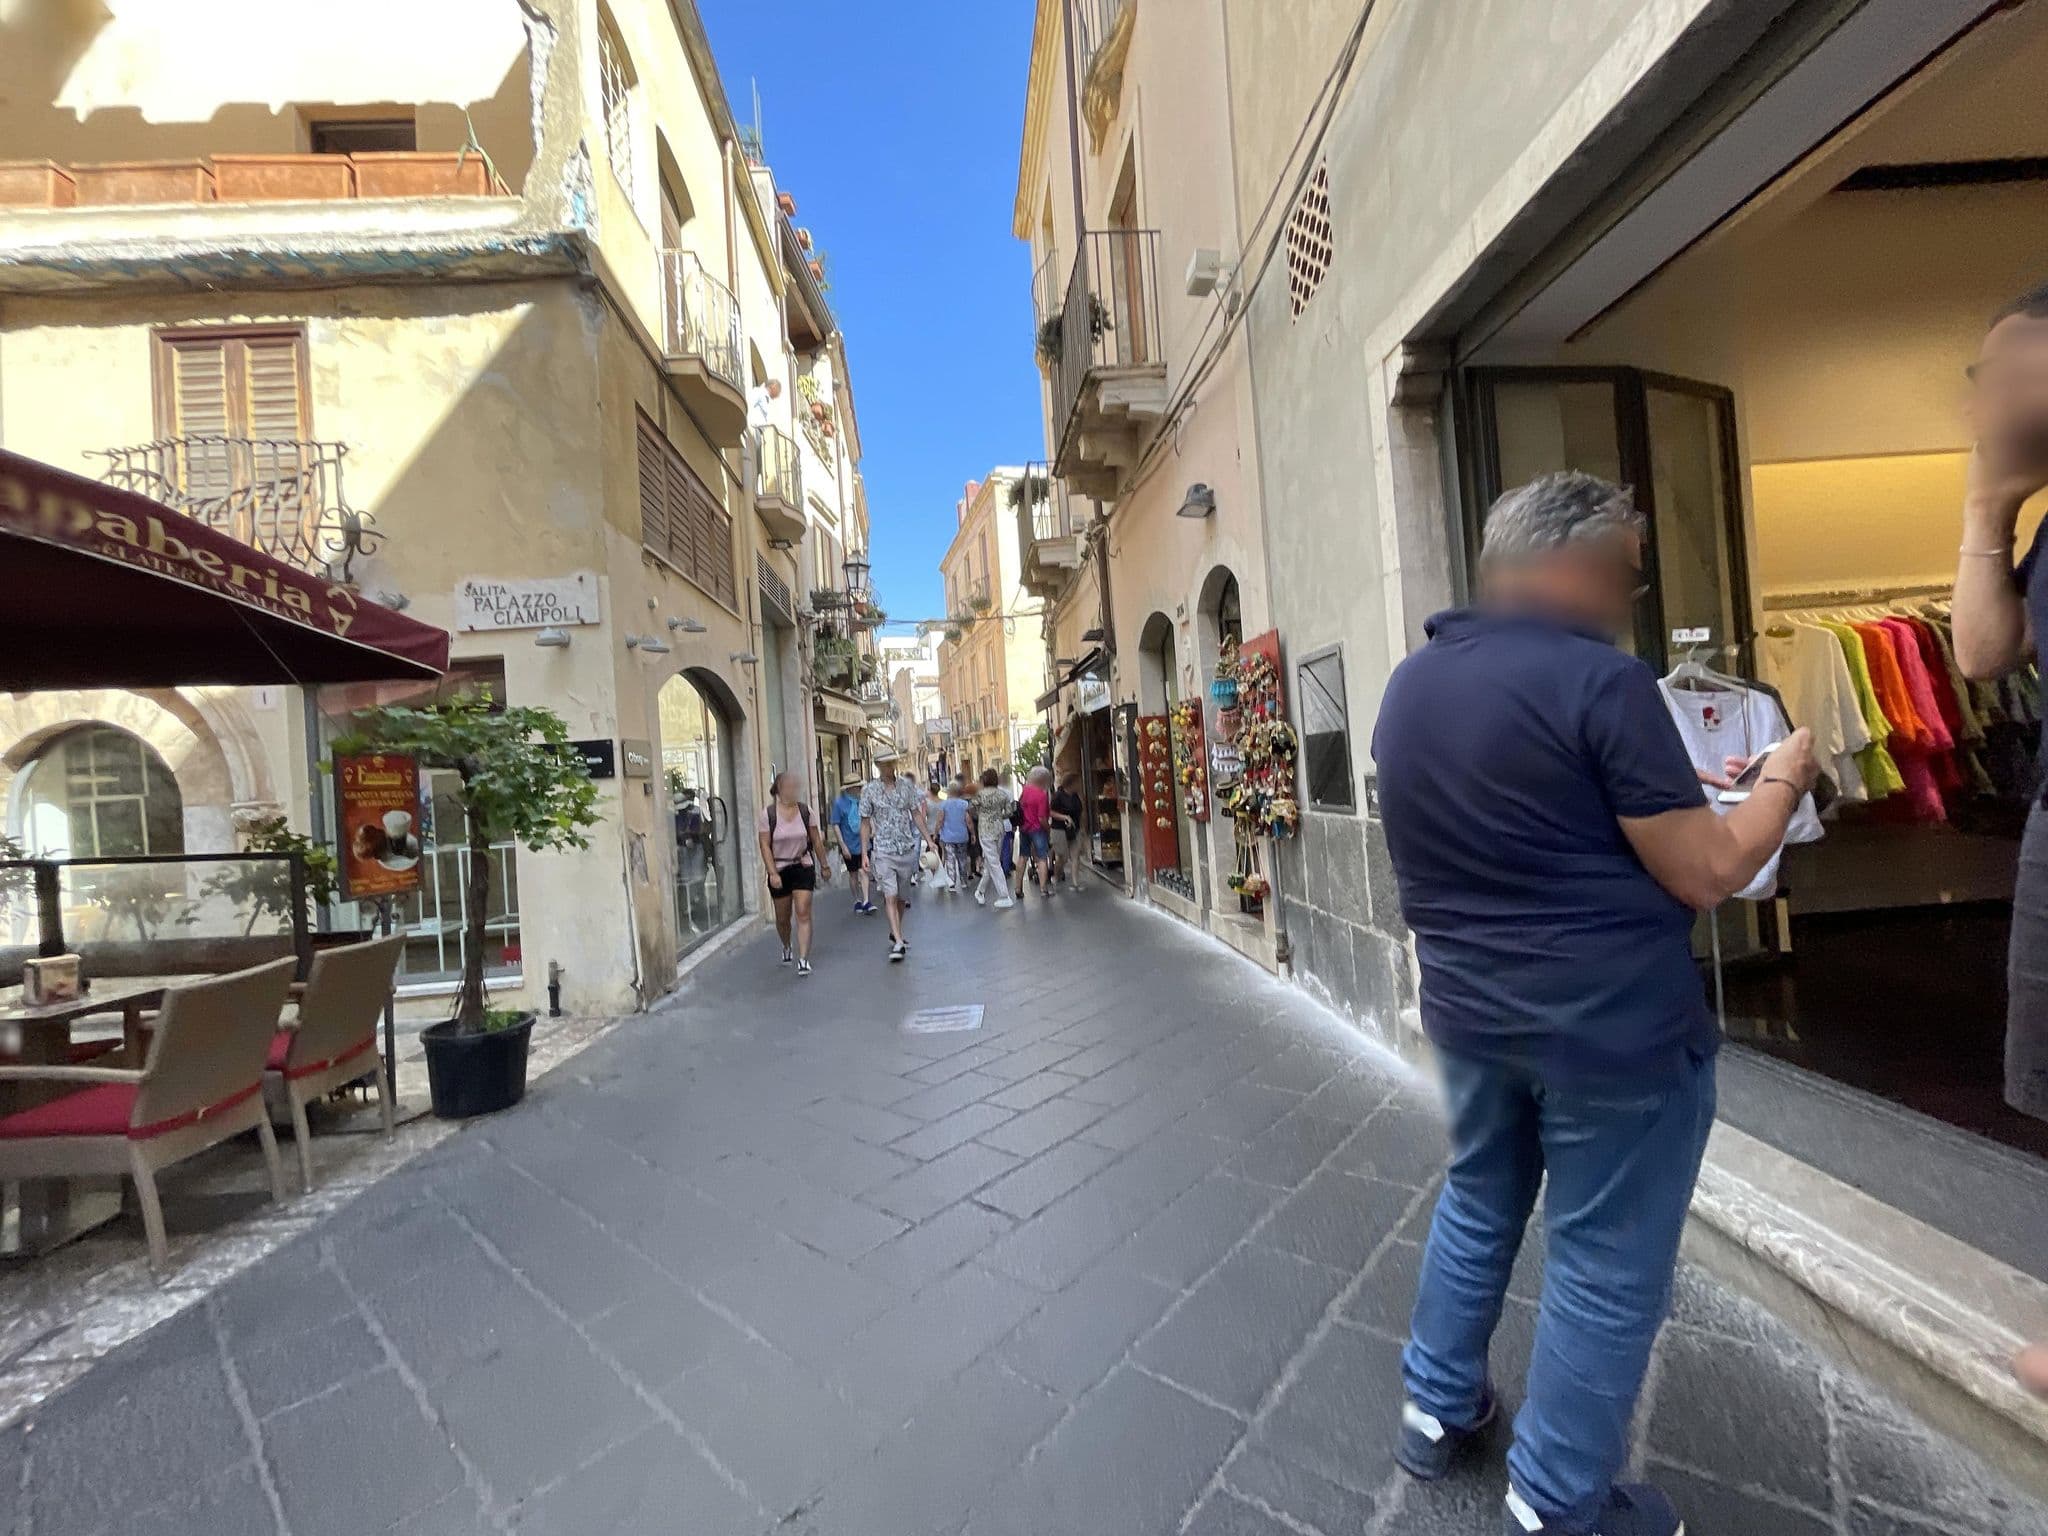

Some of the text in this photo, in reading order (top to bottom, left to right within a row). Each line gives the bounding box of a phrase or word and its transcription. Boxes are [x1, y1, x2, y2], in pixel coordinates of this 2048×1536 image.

[465, 585, 506, 597] SALITA
[474, 592, 557, 612] PALAZZO
[494, 605, 581, 625] CIAMPOLI
